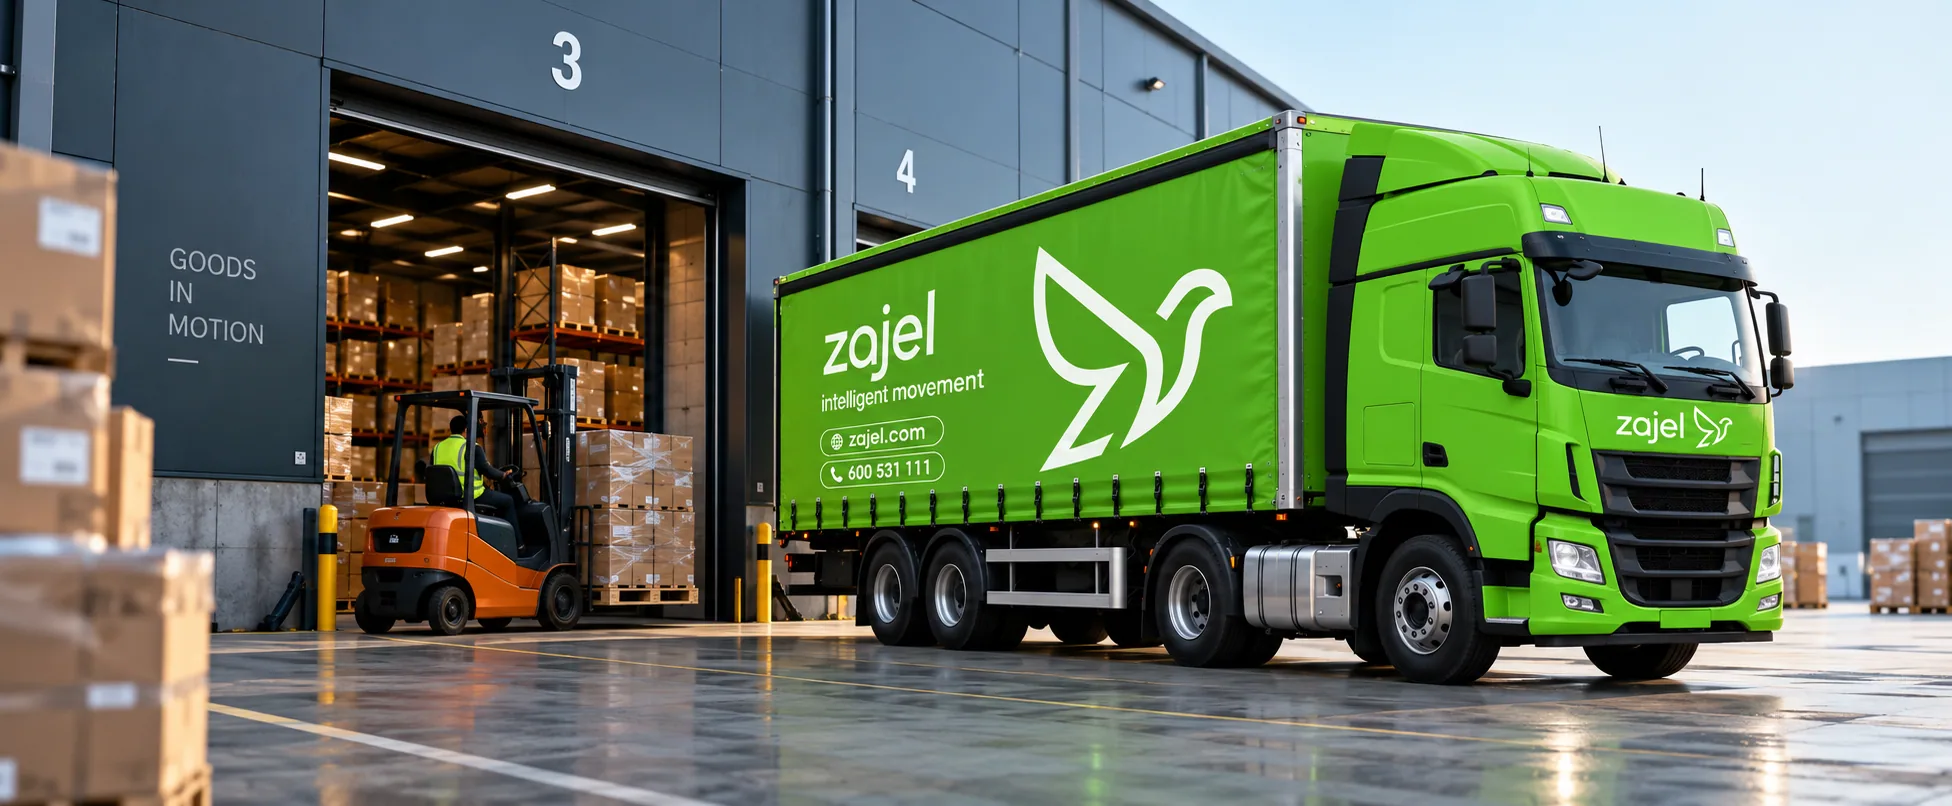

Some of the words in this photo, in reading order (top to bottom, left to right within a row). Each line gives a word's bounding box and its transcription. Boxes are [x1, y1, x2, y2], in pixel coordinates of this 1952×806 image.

[551, 31, 582, 91] 3
[896, 148, 917, 195] 4
[169, 247, 257, 281] GOODS
[169, 279, 194, 304] IN
[168, 313, 264, 345] MOTION
[823, 289, 936, 383] zajel
[821, 385, 889, 413] intelligent
[892, 368, 985, 402] movement
[848, 426, 925, 450] zajel.com
[1616, 410, 1685, 445] zajel
[848, 463, 873, 481] 600
[876, 461, 900, 479] 531
[905, 458, 930, 477] 111
